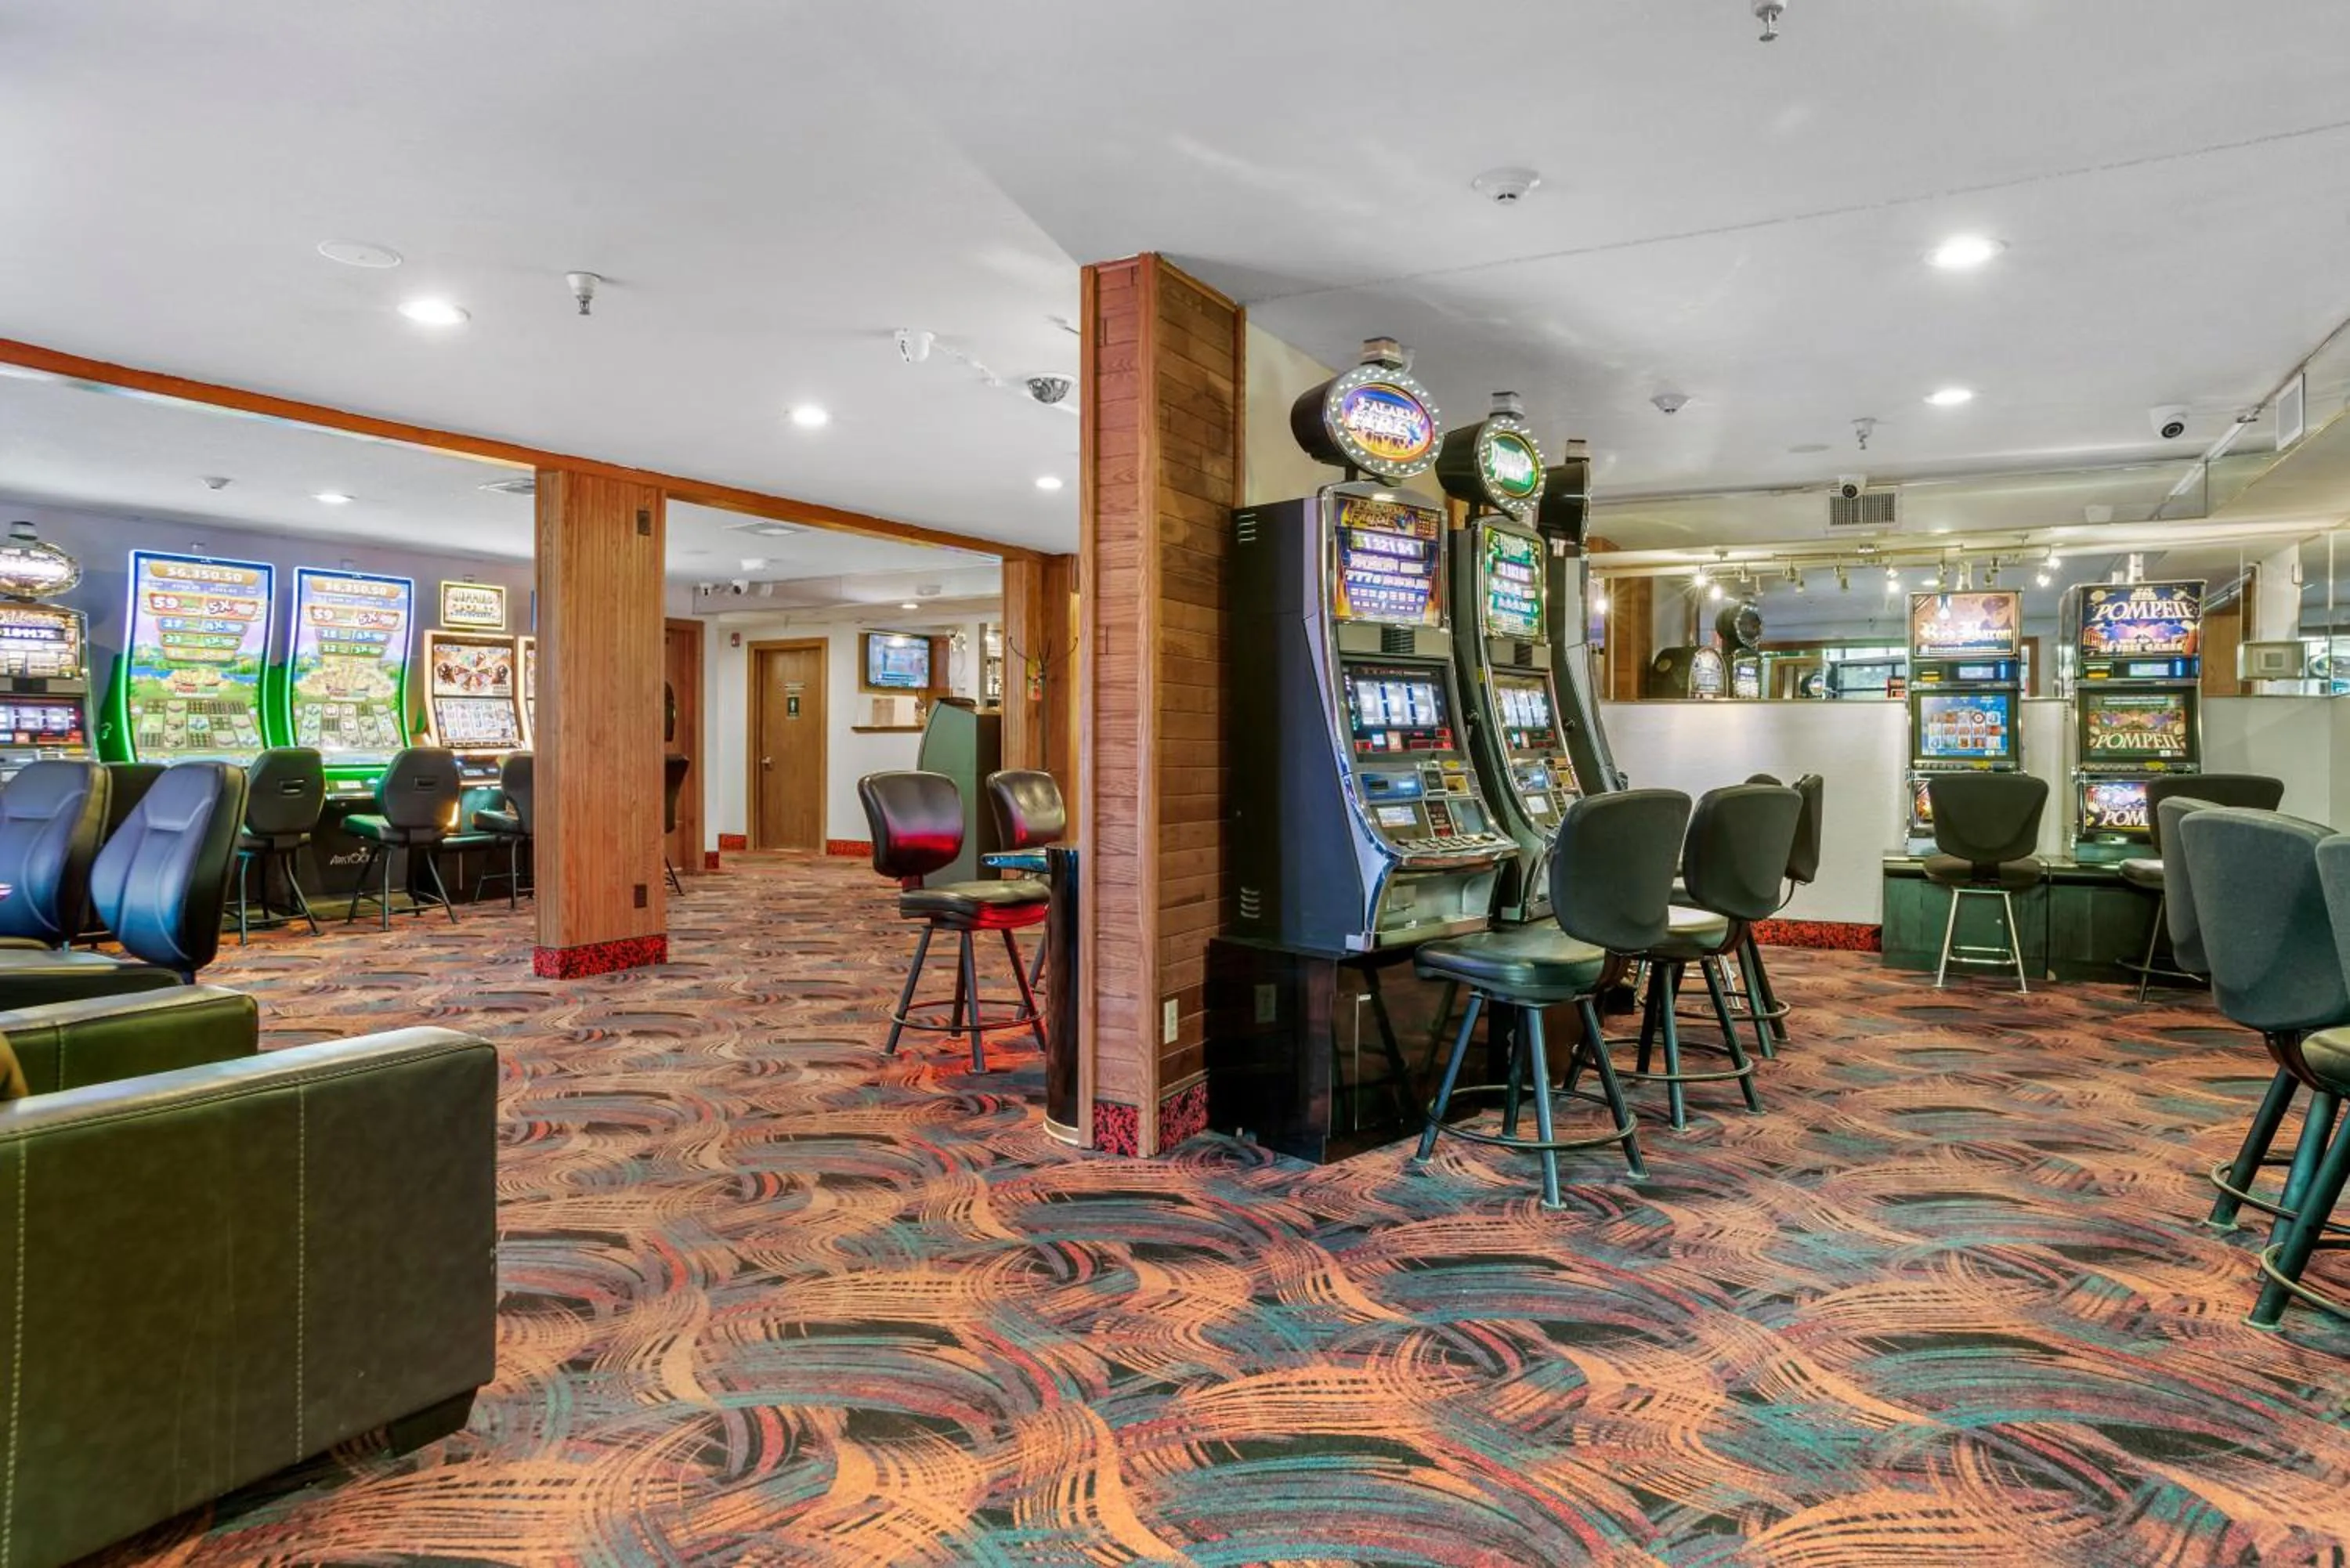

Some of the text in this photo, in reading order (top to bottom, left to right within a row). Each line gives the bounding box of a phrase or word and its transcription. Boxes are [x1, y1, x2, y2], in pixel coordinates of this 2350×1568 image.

[154, 597, 179, 609] 59
[2092, 600, 2195, 620] POMPEII
[2094, 732, 2181, 750] POMPEII
